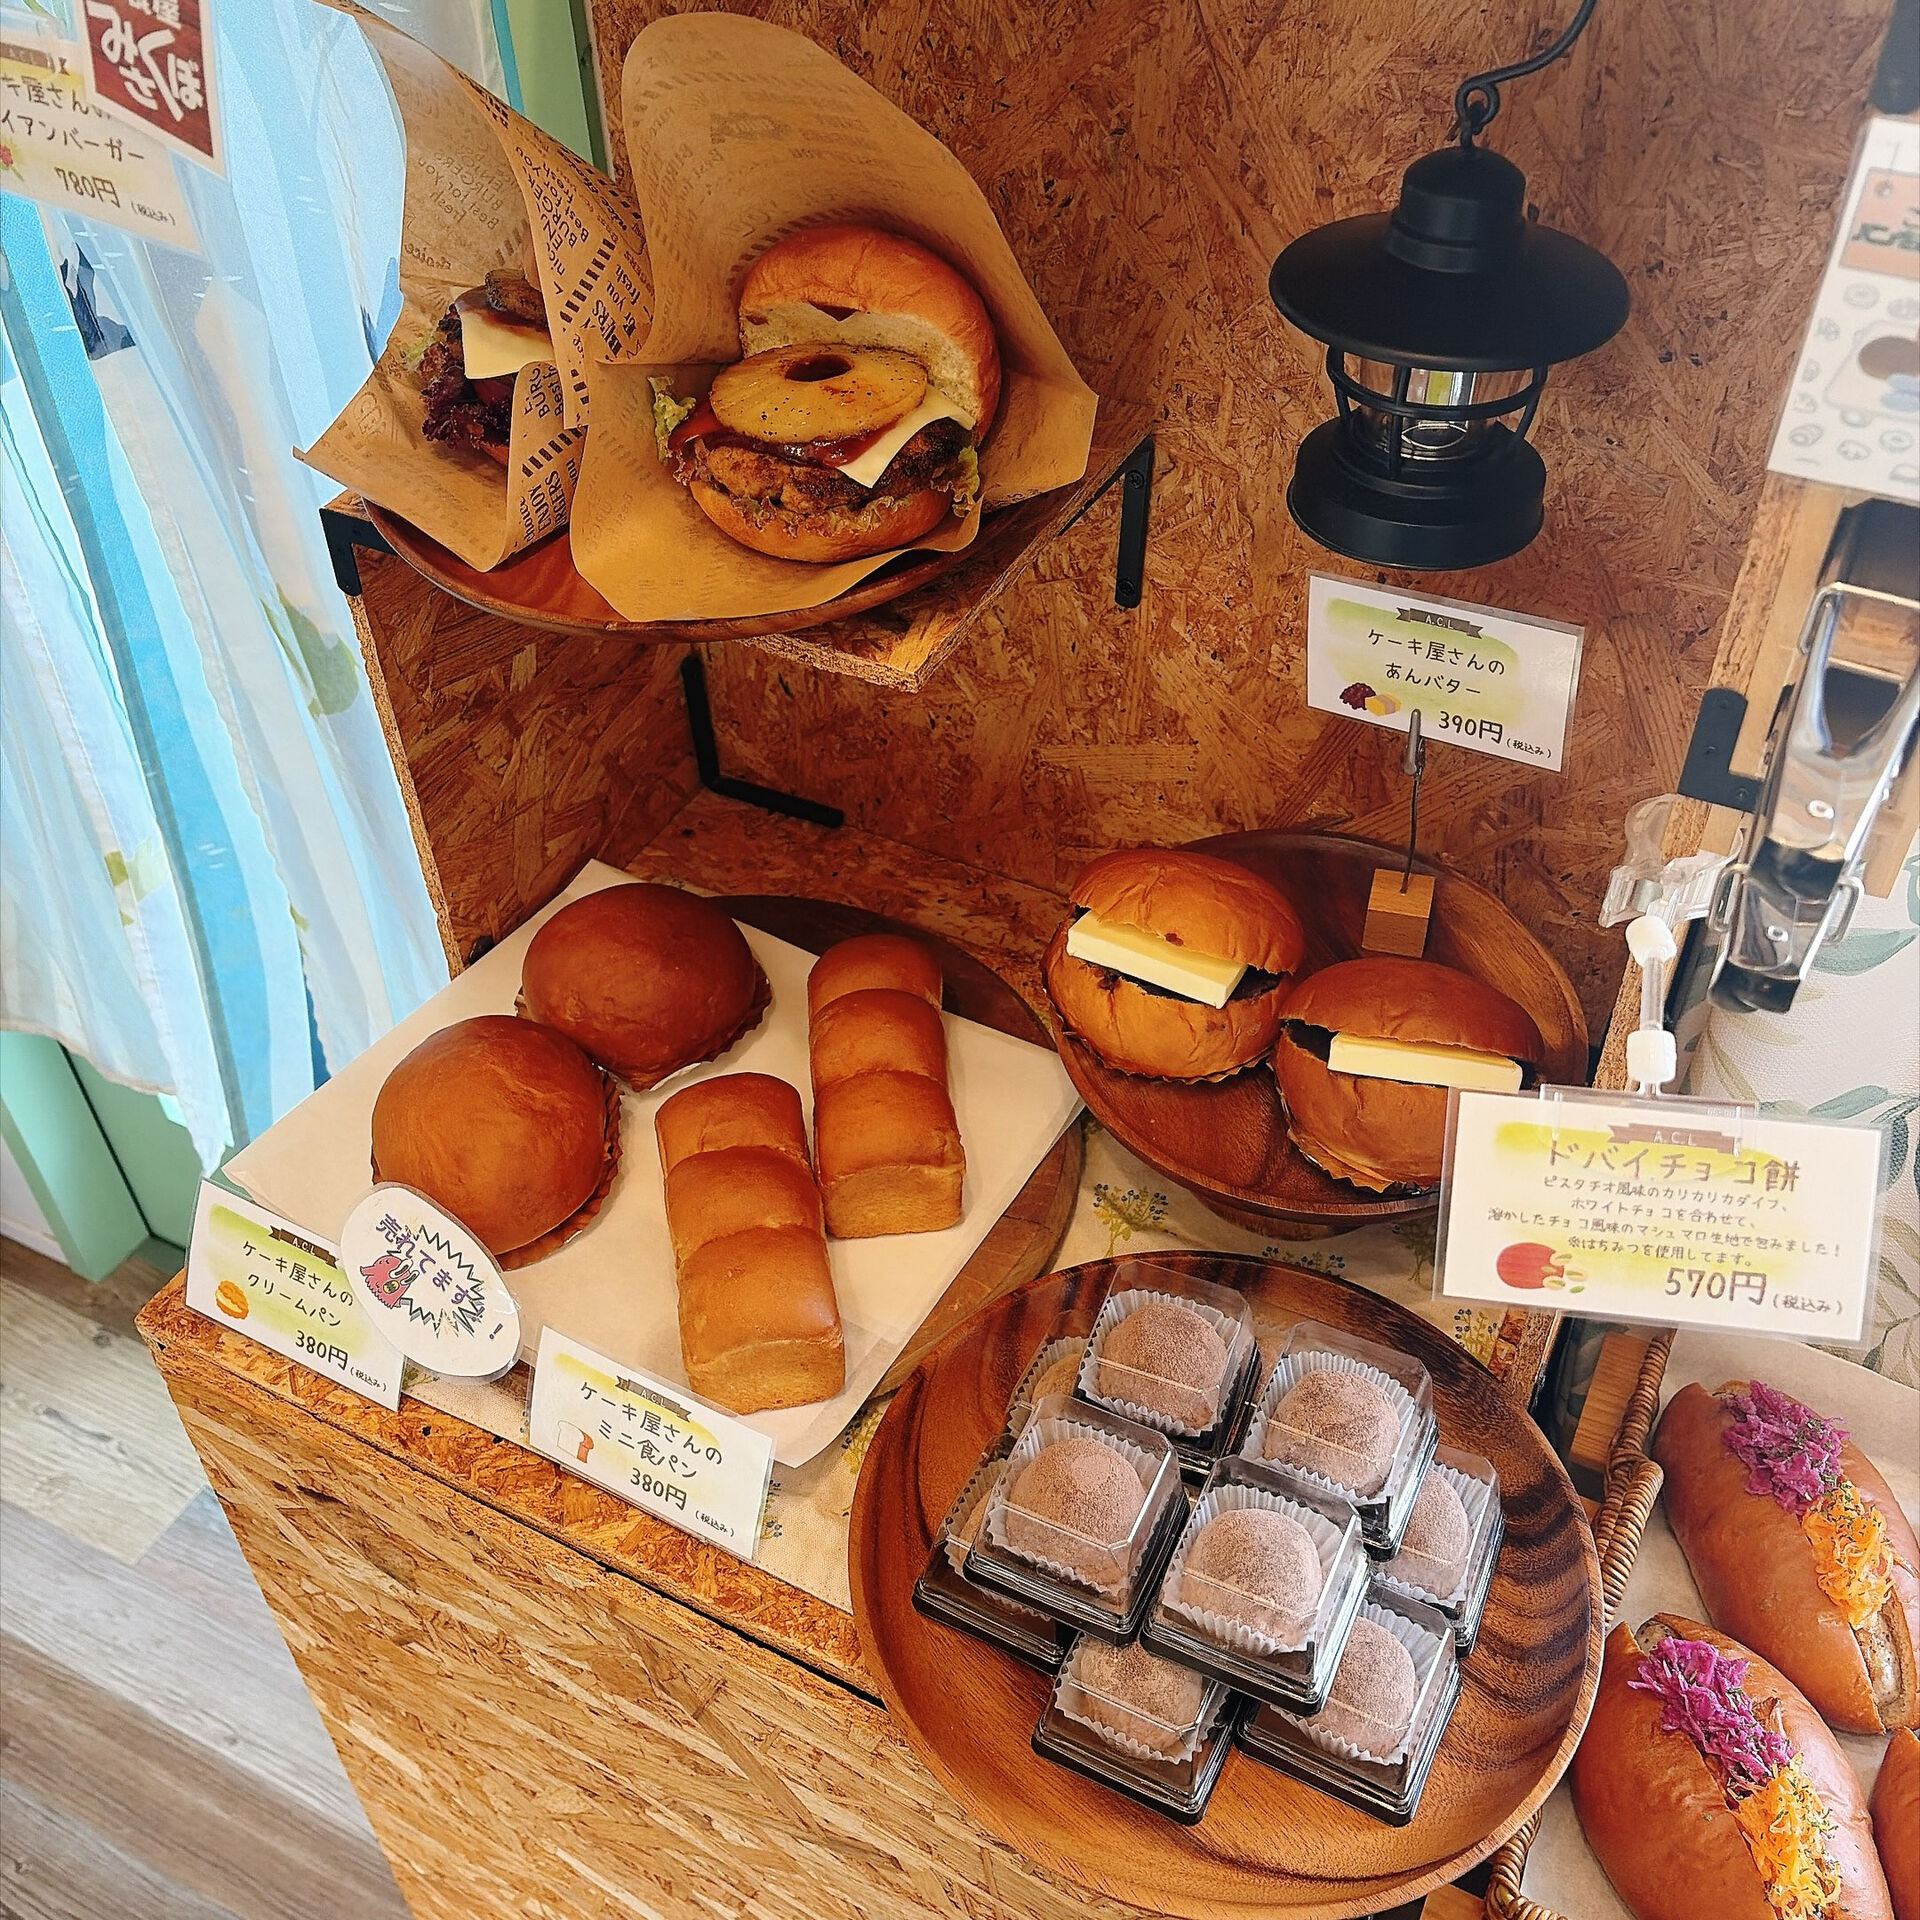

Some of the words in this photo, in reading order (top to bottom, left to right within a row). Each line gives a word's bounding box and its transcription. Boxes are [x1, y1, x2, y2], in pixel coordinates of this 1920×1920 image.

[54, 167, 122, 209] 780円
[563, 203, 591, 245] Best
[616, 262, 642, 307] fresh
[528, 483, 553, 534] ENJOY
[1367, 628, 1506, 676] ケーキ屋さんの
[1385, 662, 1481, 696] あんバター
[1437, 711, 1503, 745] 390円
[1550, 1140, 1800, 1193] ドバイチョコ餅
[1570, 1197, 1756, 1228] ホワイトチョコを合わせて、
[242, 1240, 354, 1308] ケーキ屋さんの
[1664, 1266, 1767, 1306] 570円
[247, 1274, 342, 1328] クリームパン
[295, 1329, 349, 1372] 380円
[580, 1381, 723, 1466] ケーキ屋さんの
[598, 1419, 698, 1479] ミニ食パン
[630, 1467, 687, 1511] 380円
